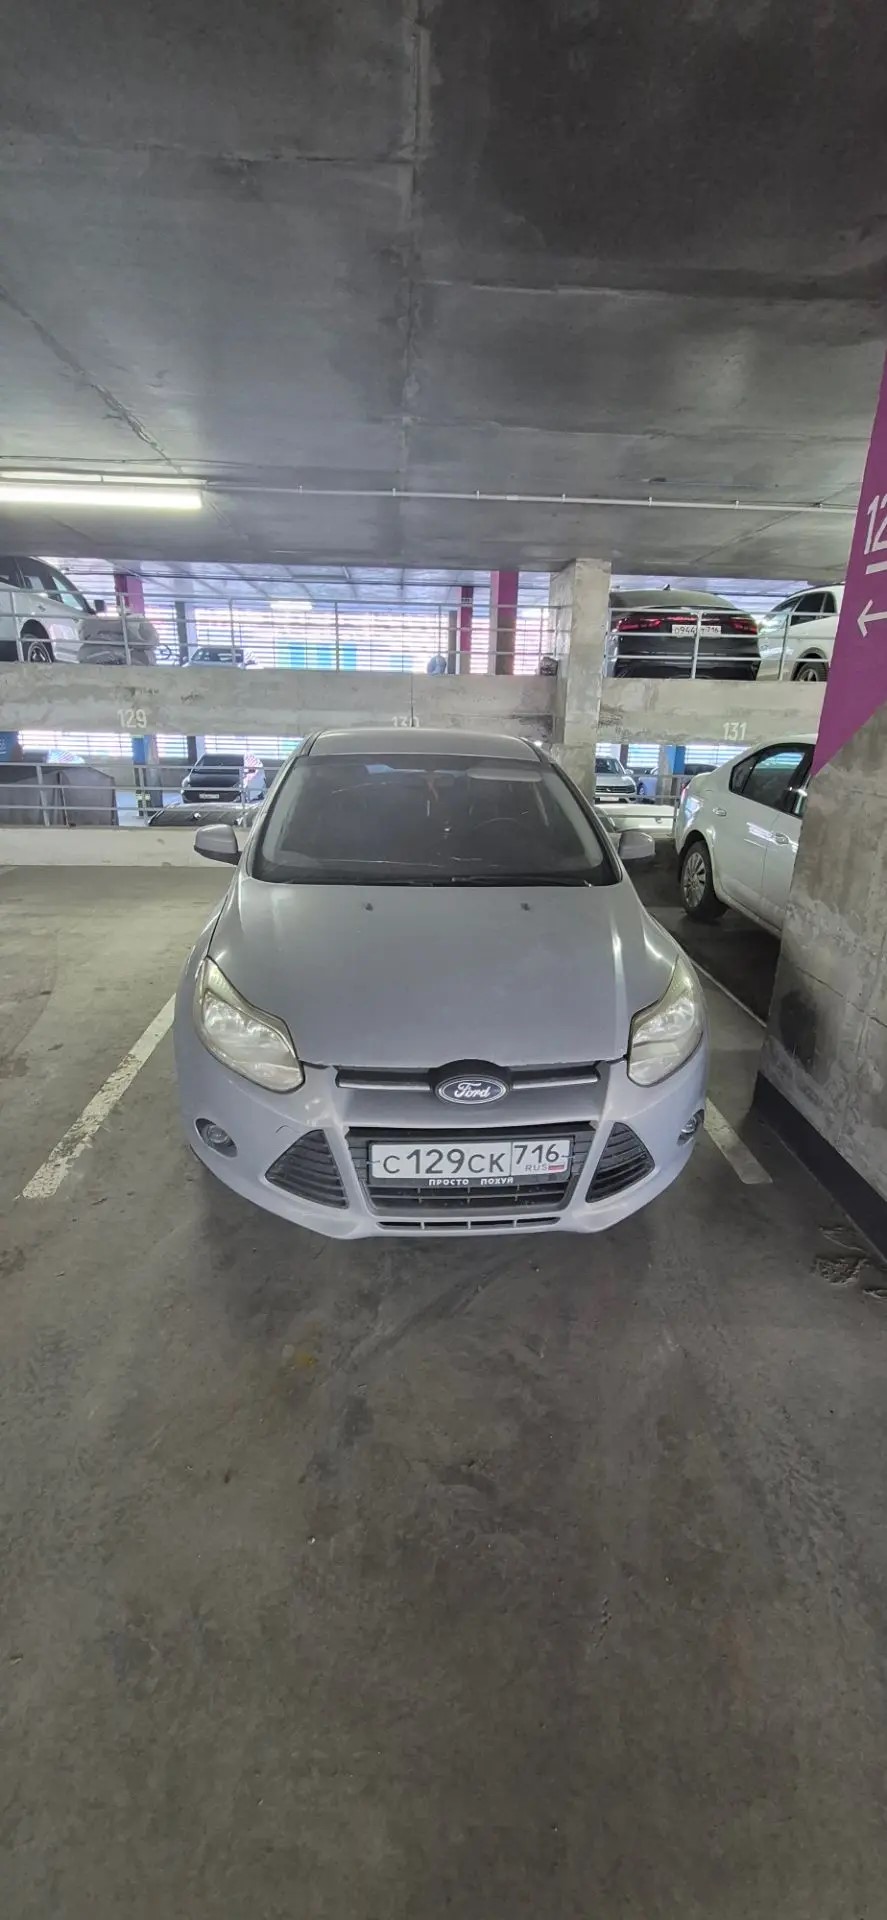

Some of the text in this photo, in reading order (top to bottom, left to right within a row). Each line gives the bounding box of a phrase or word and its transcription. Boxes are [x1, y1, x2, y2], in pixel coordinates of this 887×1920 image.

[117, 709, 147, 728] 129
[723, 722, 747, 741] 131
[454, 1082, 492, 1098] Ford
[383, 1144, 560, 1174] С129СК 716
[525, 1164, 547, 1172] RUS
[429, 1176, 514, 1187] ПРОСТО ПОХУЙ
